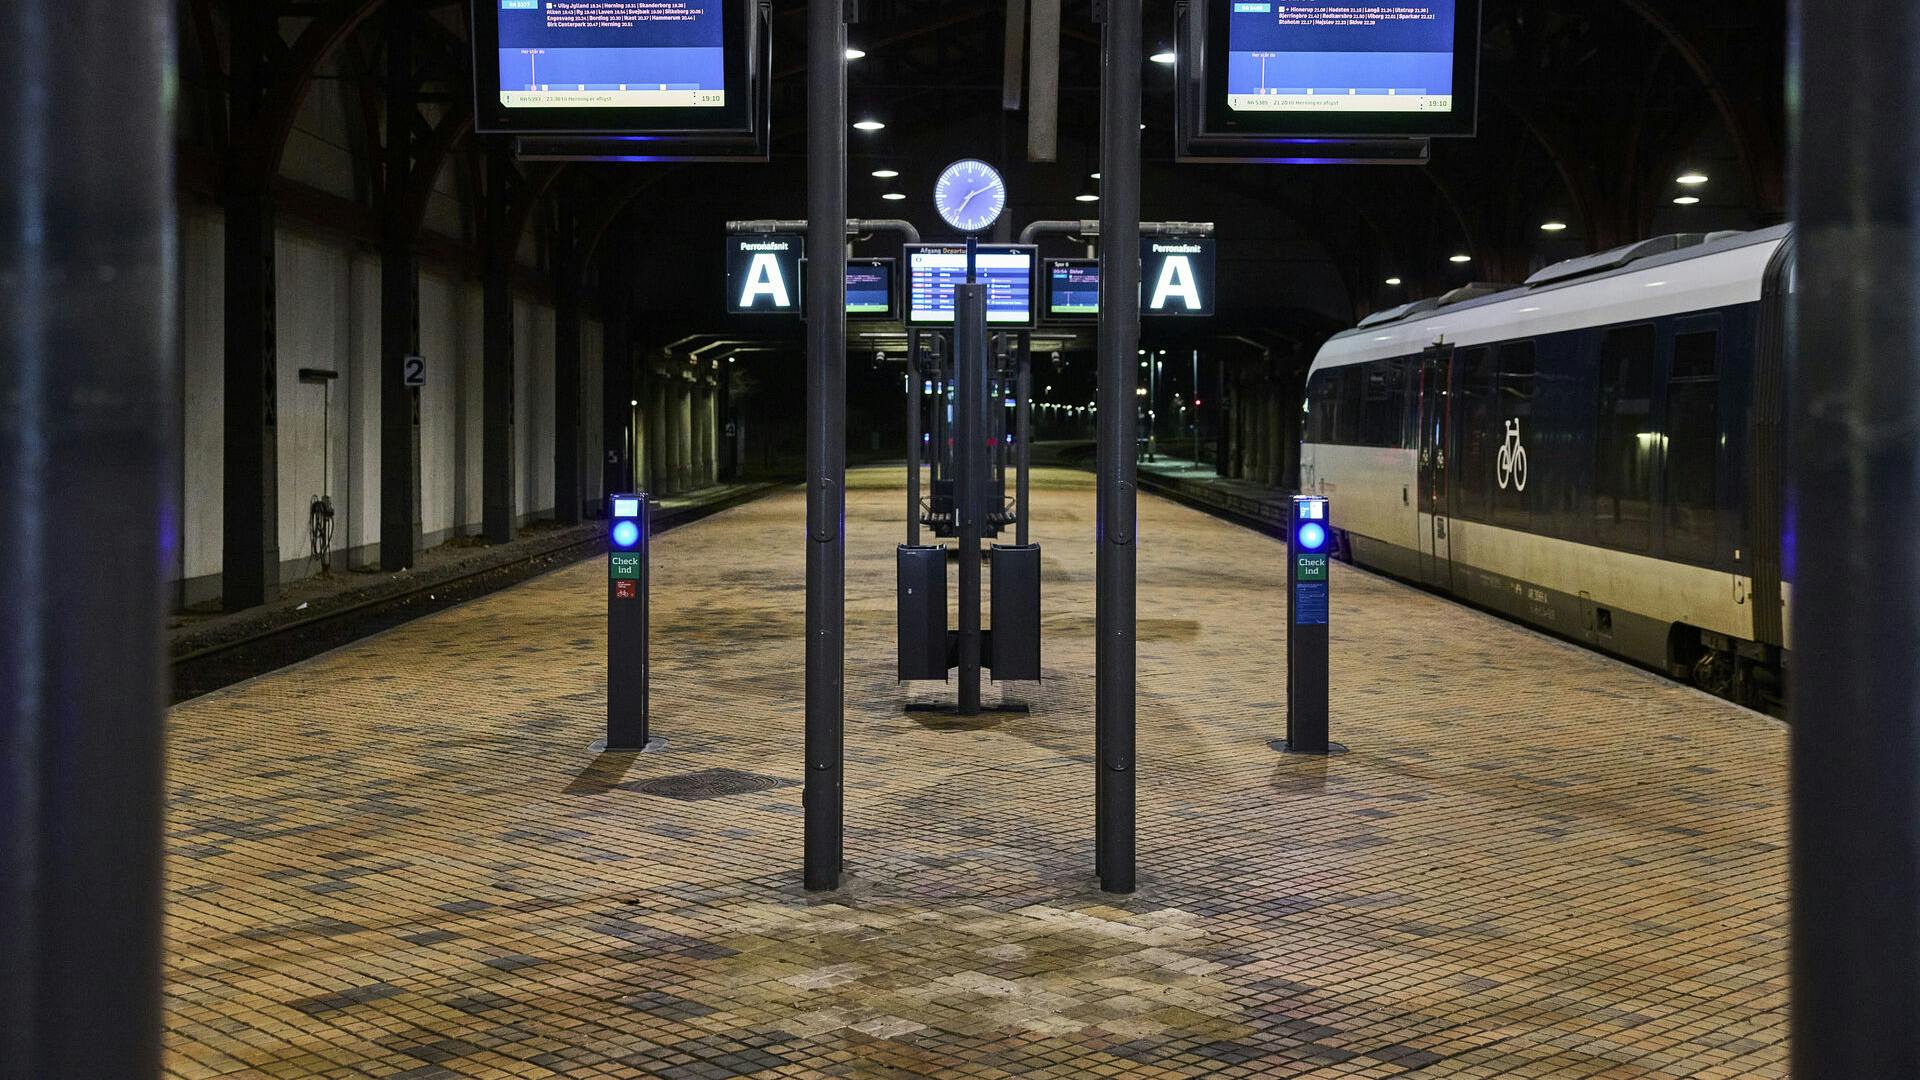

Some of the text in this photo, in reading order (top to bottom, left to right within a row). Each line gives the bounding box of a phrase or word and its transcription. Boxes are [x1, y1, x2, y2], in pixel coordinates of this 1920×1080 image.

[741, 242, 789, 251] Perronafsnit
[1153, 244, 1201, 253] Perronafsnit
[739, 254, 791, 307] A
[1150, 256, 1202, 309] A
[406, 359, 424, 384] 2
[612, 557, 638, 565] Check
[1299, 558, 1325, 566] Check
[618, 566, 632, 574] ind
[1305, 567, 1319, 575] ind
